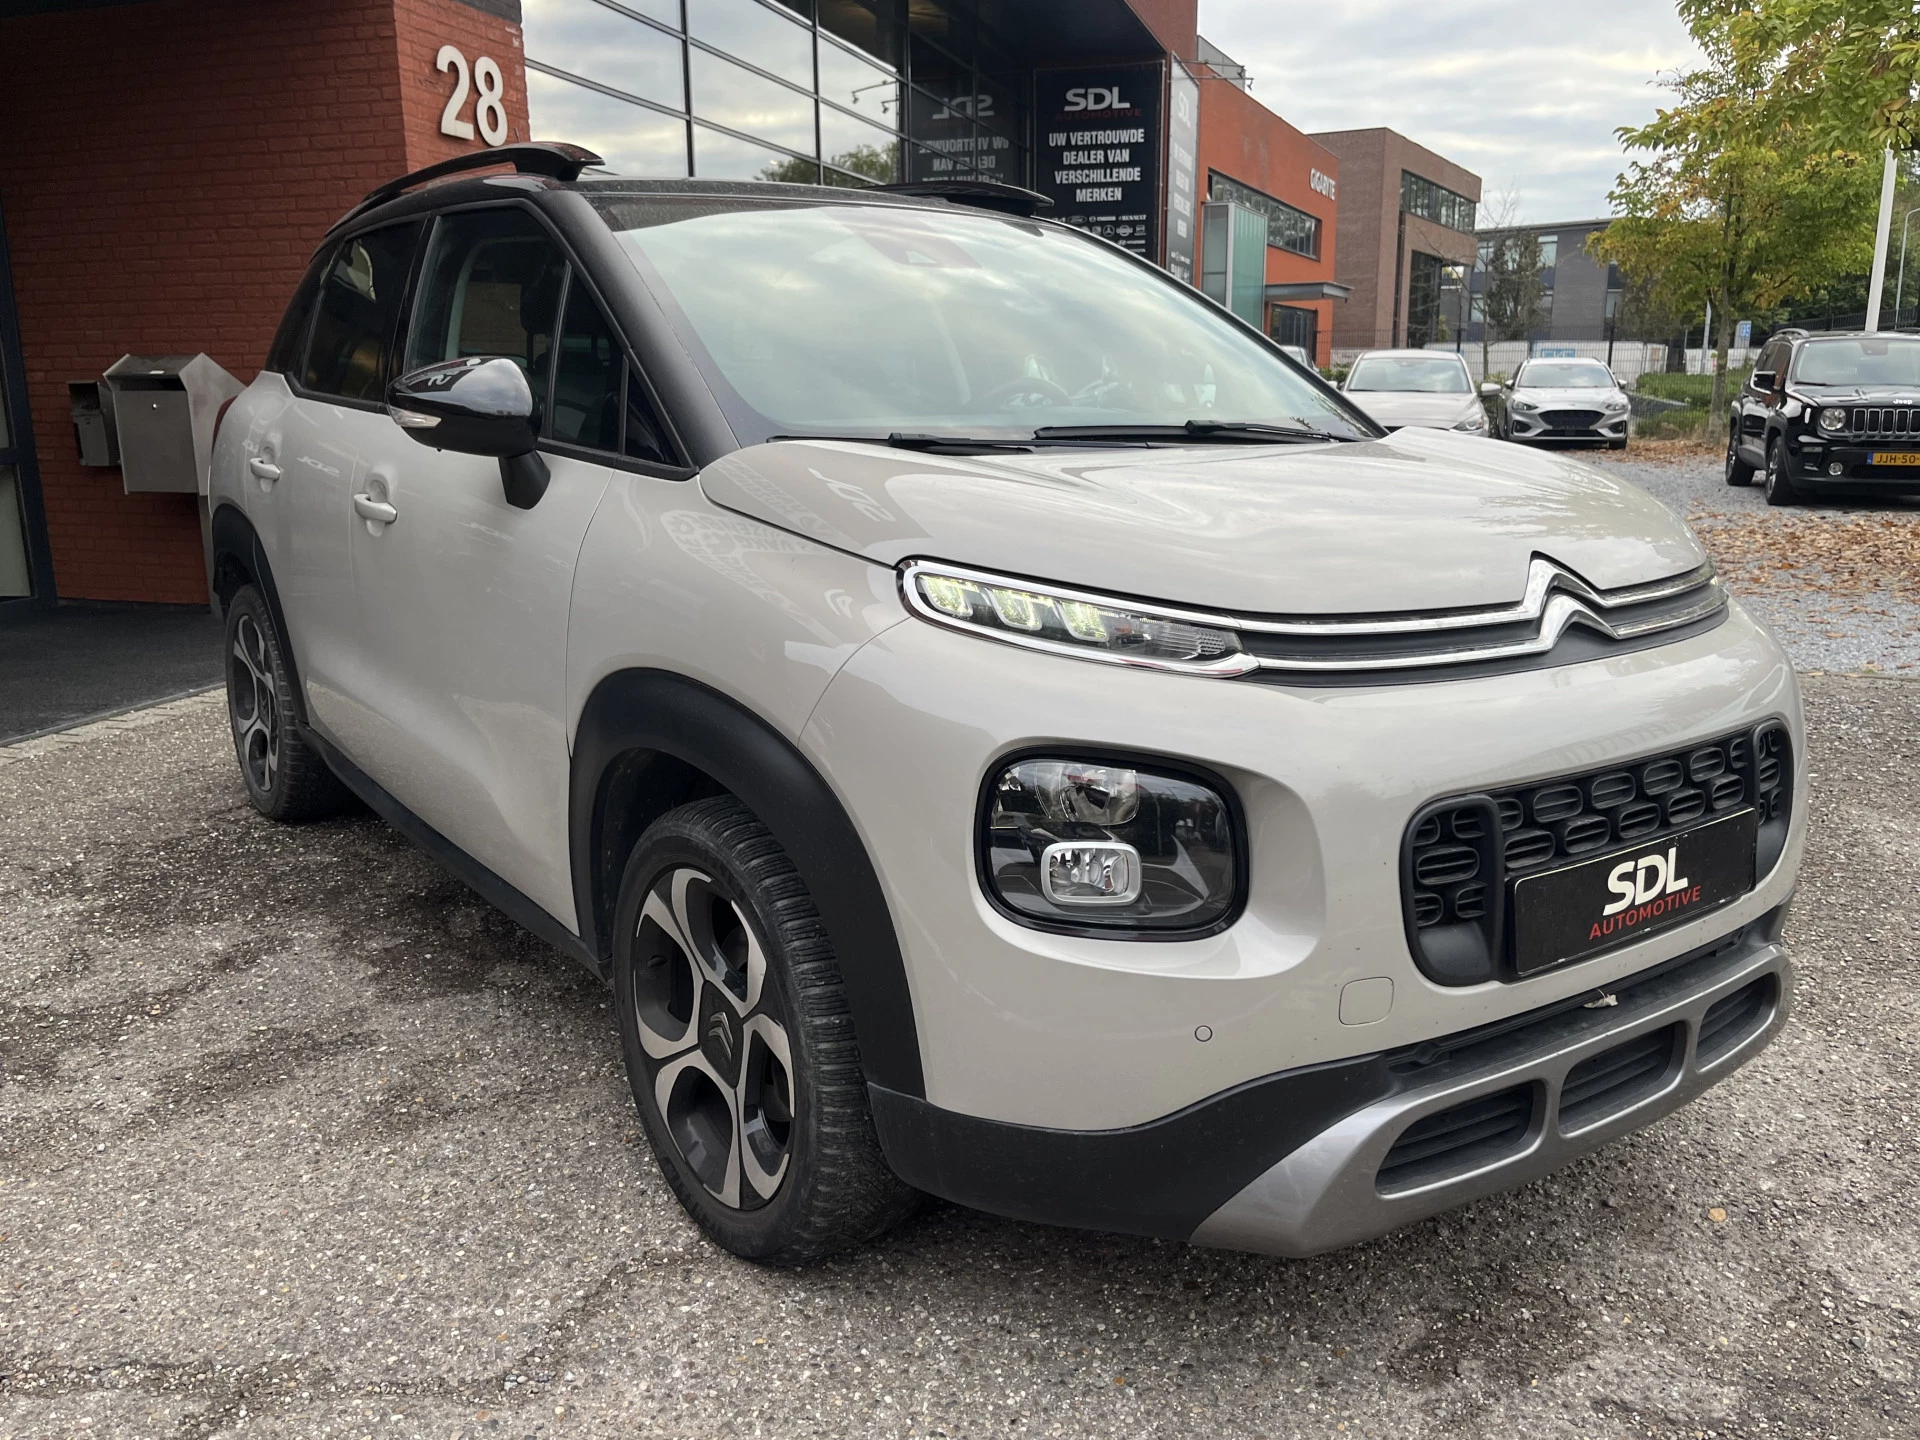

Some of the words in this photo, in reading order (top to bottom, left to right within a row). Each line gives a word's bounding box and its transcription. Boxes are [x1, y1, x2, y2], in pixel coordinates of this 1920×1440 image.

[436, 44, 508, 147] 28
[1063, 86, 1131, 112] SDL
[1048, 133, 1067, 147] UW
[1069, 128, 1145, 146] VERTROUWDE
[1063, 149, 1105, 165] DEALER
[1107, 148, 1130, 163] VAN
[1054, 167, 1141, 185] VERSCHILLENDE
[1075, 187, 1123, 203] MERKEN
[1892, 398, 1913, 406] Jeep
[1602, 846, 1689, 916] SDL
[1588, 884, 1702, 941] AUTOMOTIVE
